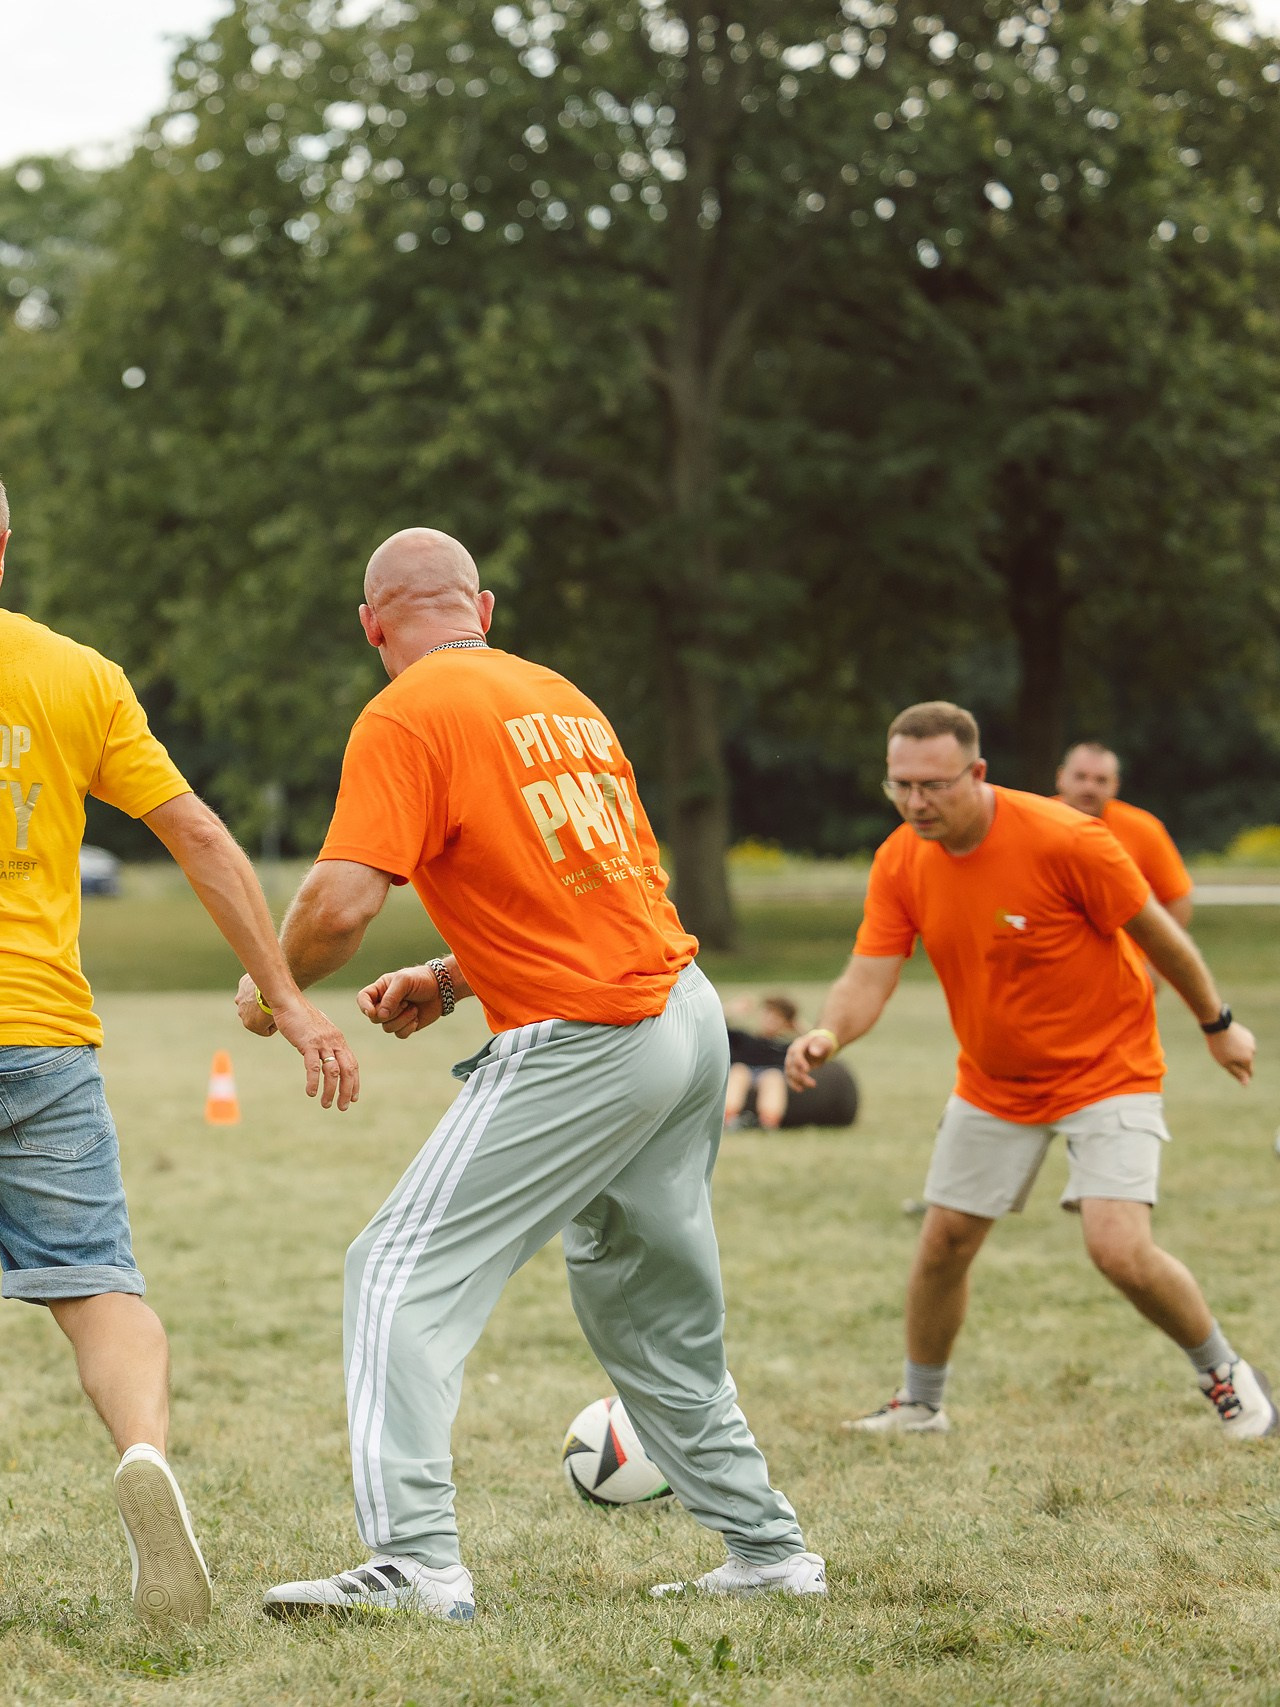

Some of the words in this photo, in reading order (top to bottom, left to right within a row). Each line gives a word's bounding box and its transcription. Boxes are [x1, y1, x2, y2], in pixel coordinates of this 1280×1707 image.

[504, 712, 563, 769] PIT
[552, 714, 614, 763] STOP
[520, 771, 640, 864] PARTY
[8, 860, 38, 871] REST
[561, 861, 610, 886] WHERE
[574, 878, 603, 896] AND
[604, 868, 629, 884] THE
